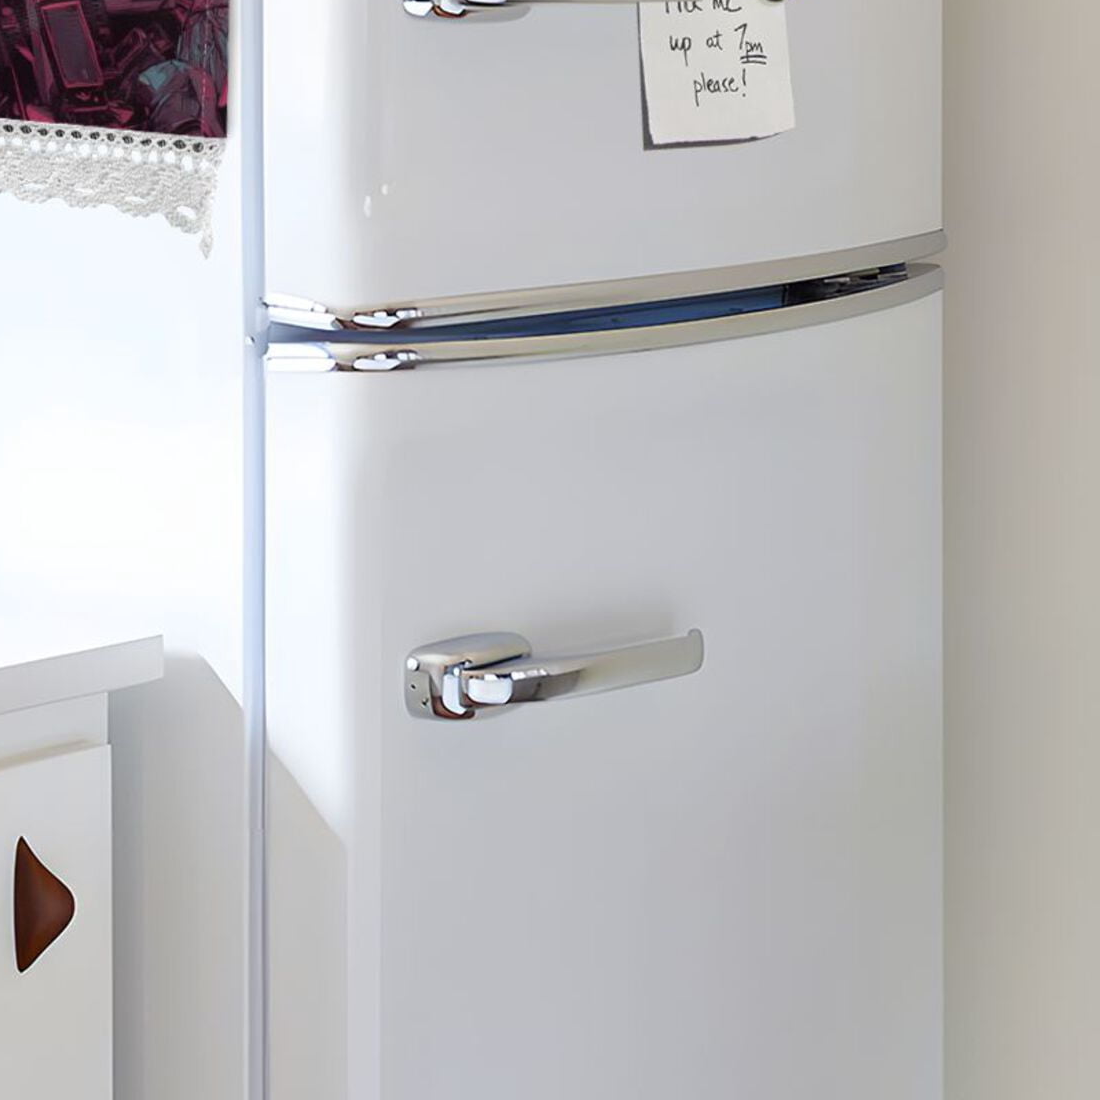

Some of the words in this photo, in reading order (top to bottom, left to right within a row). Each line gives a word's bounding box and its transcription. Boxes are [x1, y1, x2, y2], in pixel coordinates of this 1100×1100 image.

[669, 35, 692, 67] up
[706, 30, 723, 50] at
[693, 68, 747, 107] please!
